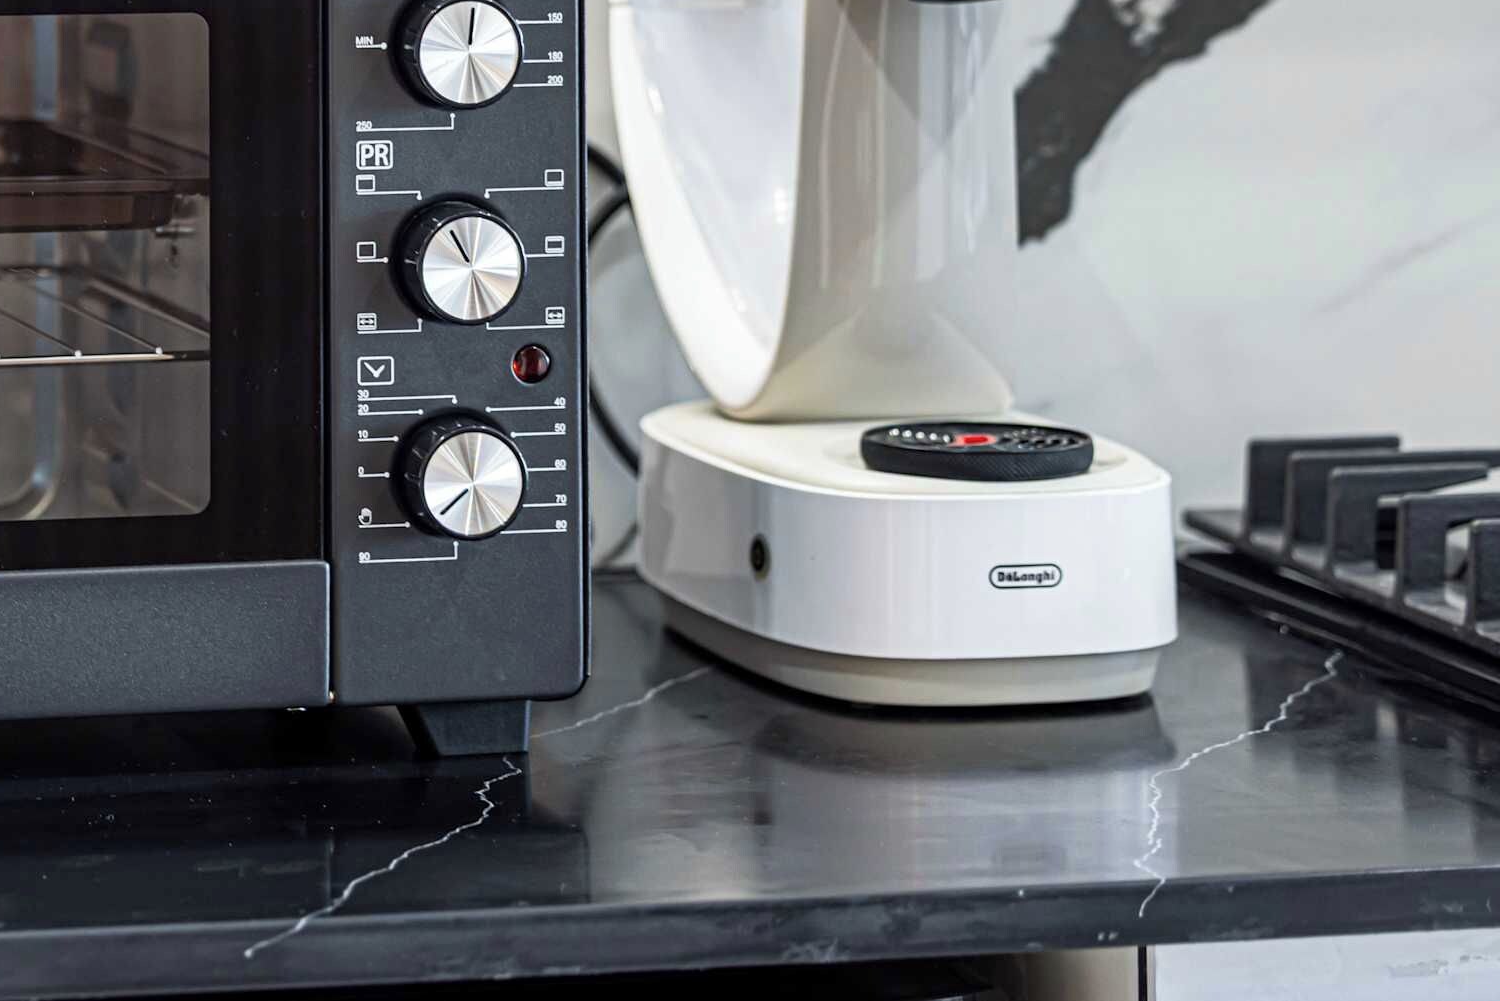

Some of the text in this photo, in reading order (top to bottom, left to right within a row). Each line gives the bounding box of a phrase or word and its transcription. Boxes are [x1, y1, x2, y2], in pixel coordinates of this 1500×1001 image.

[547, 12, 563, 22] 150
[355, 36, 374, 46] MIN
[547, 51, 563, 61] 180
[547, 75, 563, 85] 200
[355, 120, 372, 130] 250
[360, 144, 389, 166] PR
[357, 389, 370, 399] 30
[553, 397, 566, 406] 40
[357, 403, 370, 413] 20
[554, 422, 567, 432] 50
[357, 429, 369, 439] 10
[357, 466, 365, 475] 0
[555, 494, 567, 503] 70
[358, 552, 371, 561] 90
